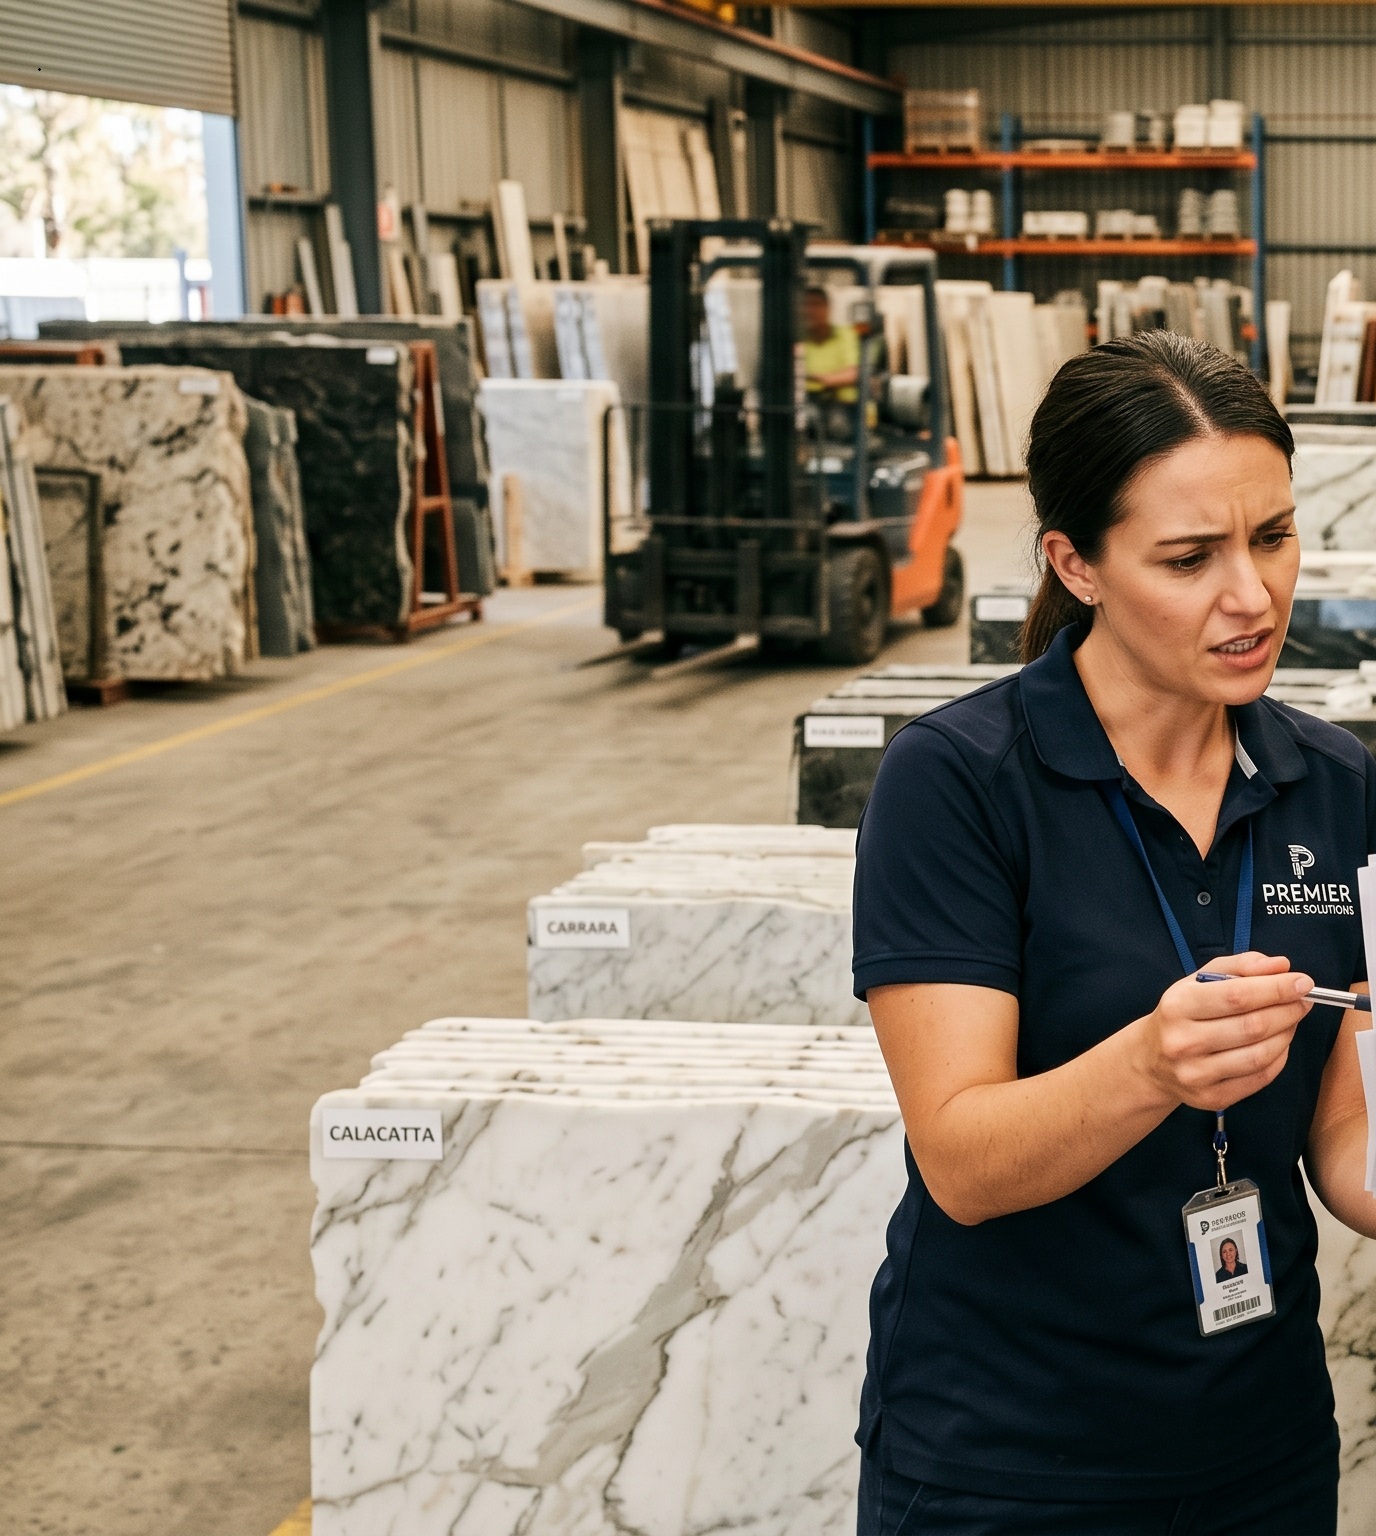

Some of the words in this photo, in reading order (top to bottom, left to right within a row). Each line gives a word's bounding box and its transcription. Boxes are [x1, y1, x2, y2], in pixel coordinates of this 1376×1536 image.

[1262, 883, 1352, 903] PREMIER
[1267, 905, 1301, 915] STONE
[1303, 905, 1354, 915] SOLUTIONS
[547, 921, 618, 934] CARRARA
[330, 1126, 435, 1142] CALACATTA
